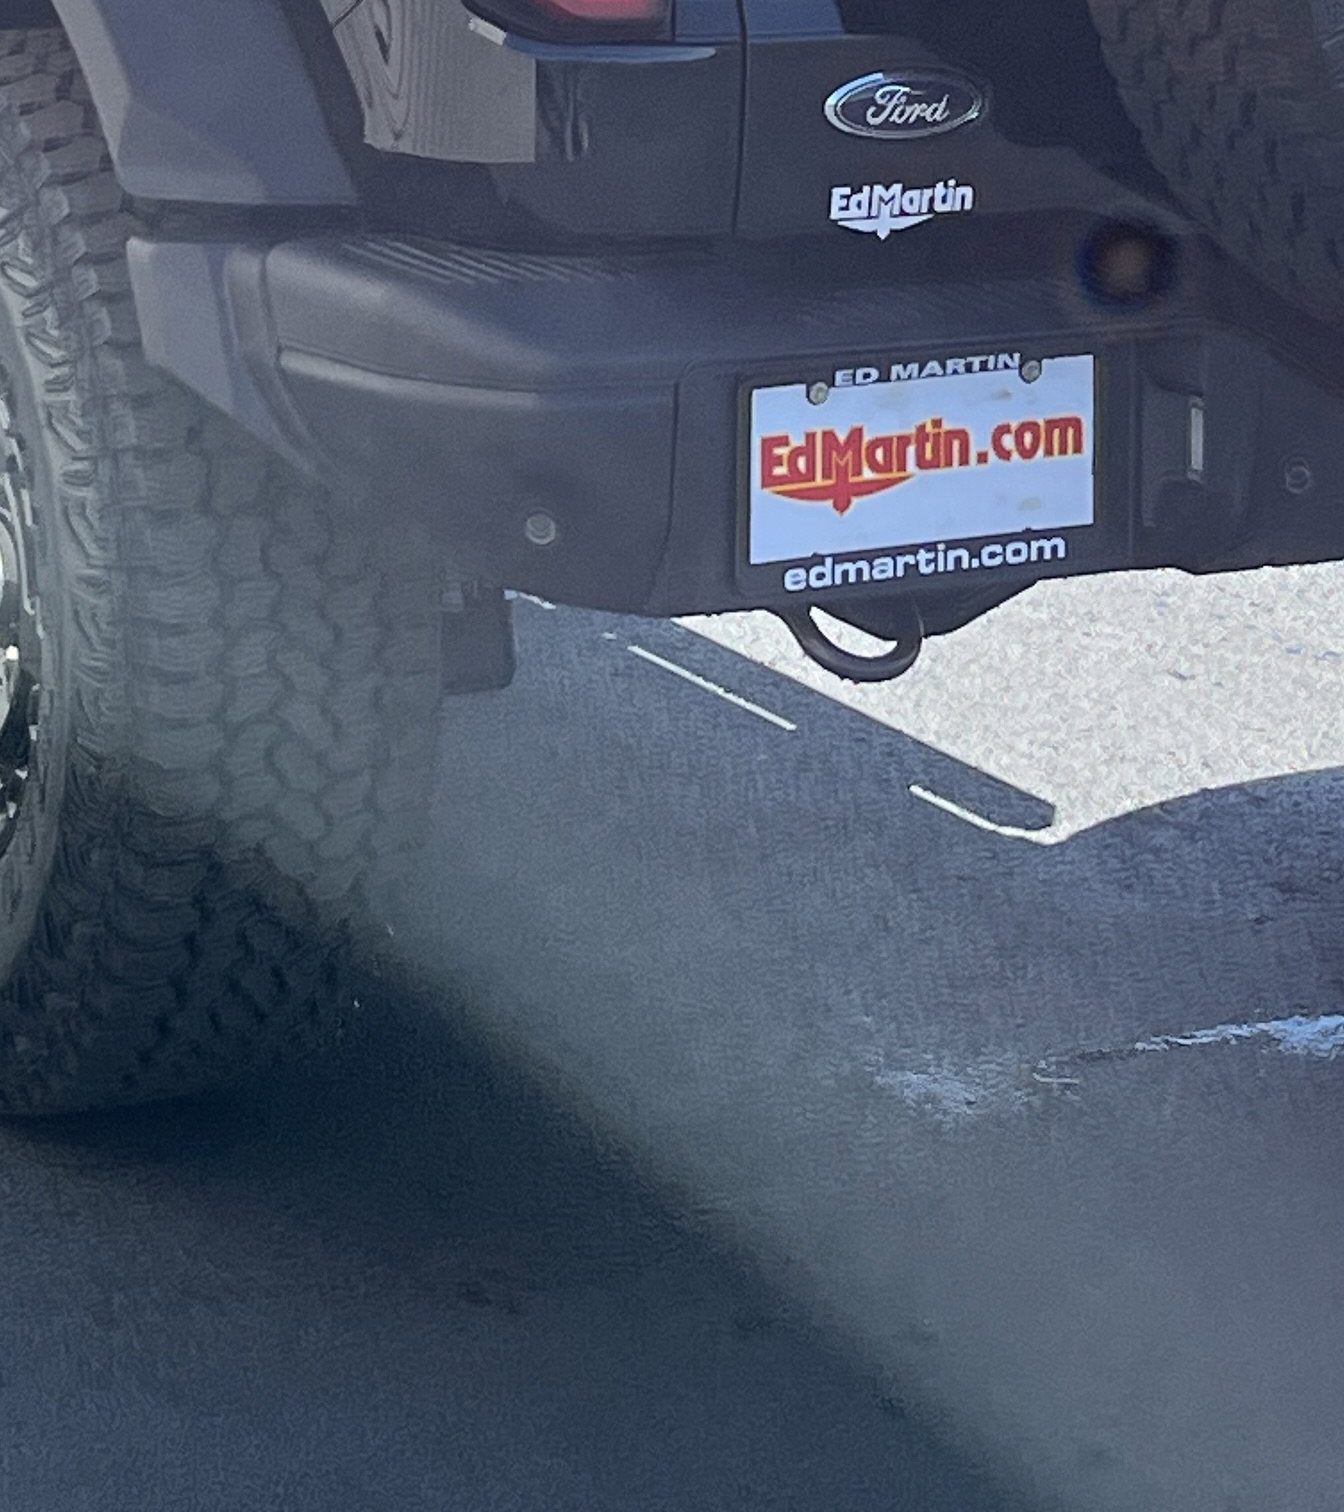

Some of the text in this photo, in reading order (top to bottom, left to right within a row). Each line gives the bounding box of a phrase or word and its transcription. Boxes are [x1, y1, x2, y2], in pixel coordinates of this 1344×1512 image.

[866, 84, 951, 126] Ford
[834, 352, 1022, 388] ED MARTIN
[760, 416, 1084, 498] EdMartin.com
[783, 535, 1067, 593] edmartin.com
